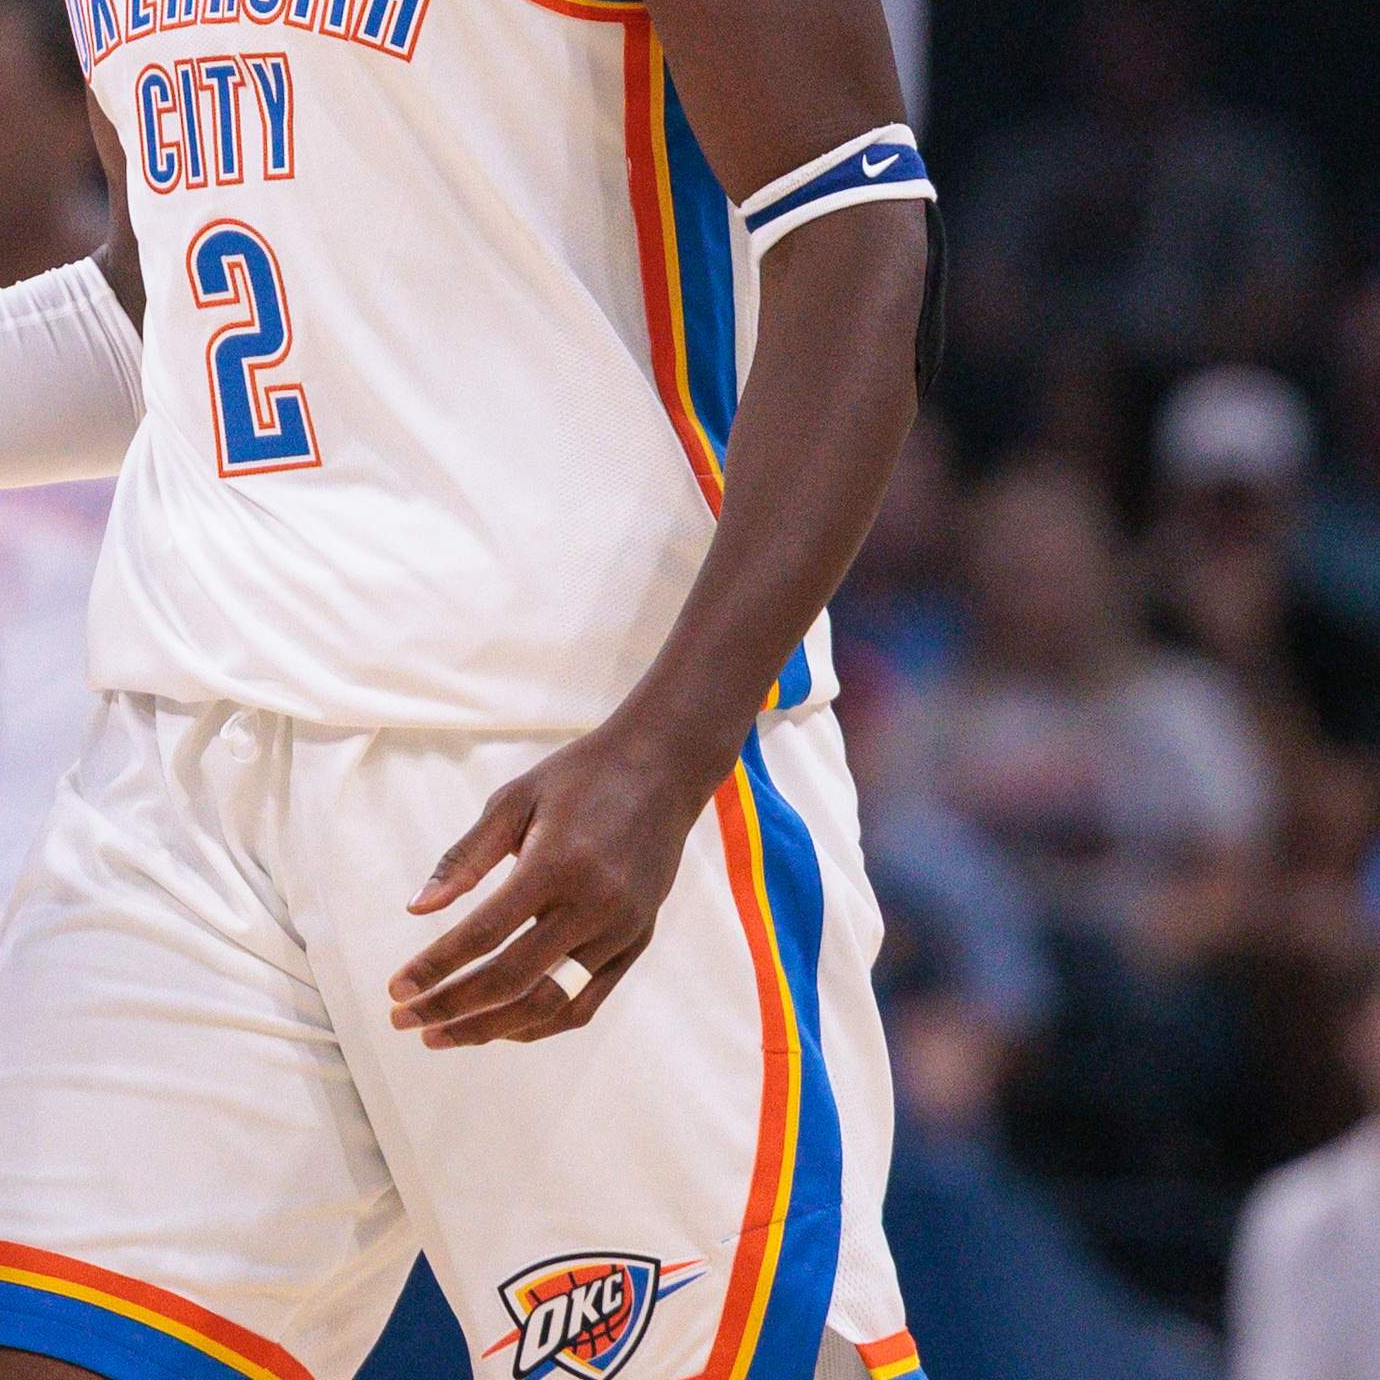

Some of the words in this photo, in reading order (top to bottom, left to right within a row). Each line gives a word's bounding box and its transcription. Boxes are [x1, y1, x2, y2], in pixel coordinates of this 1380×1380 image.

[135, 51, 295, 195] CITY
[185, 218, 323, 478] 2
[515, 1271, 625, 1377] OKC
